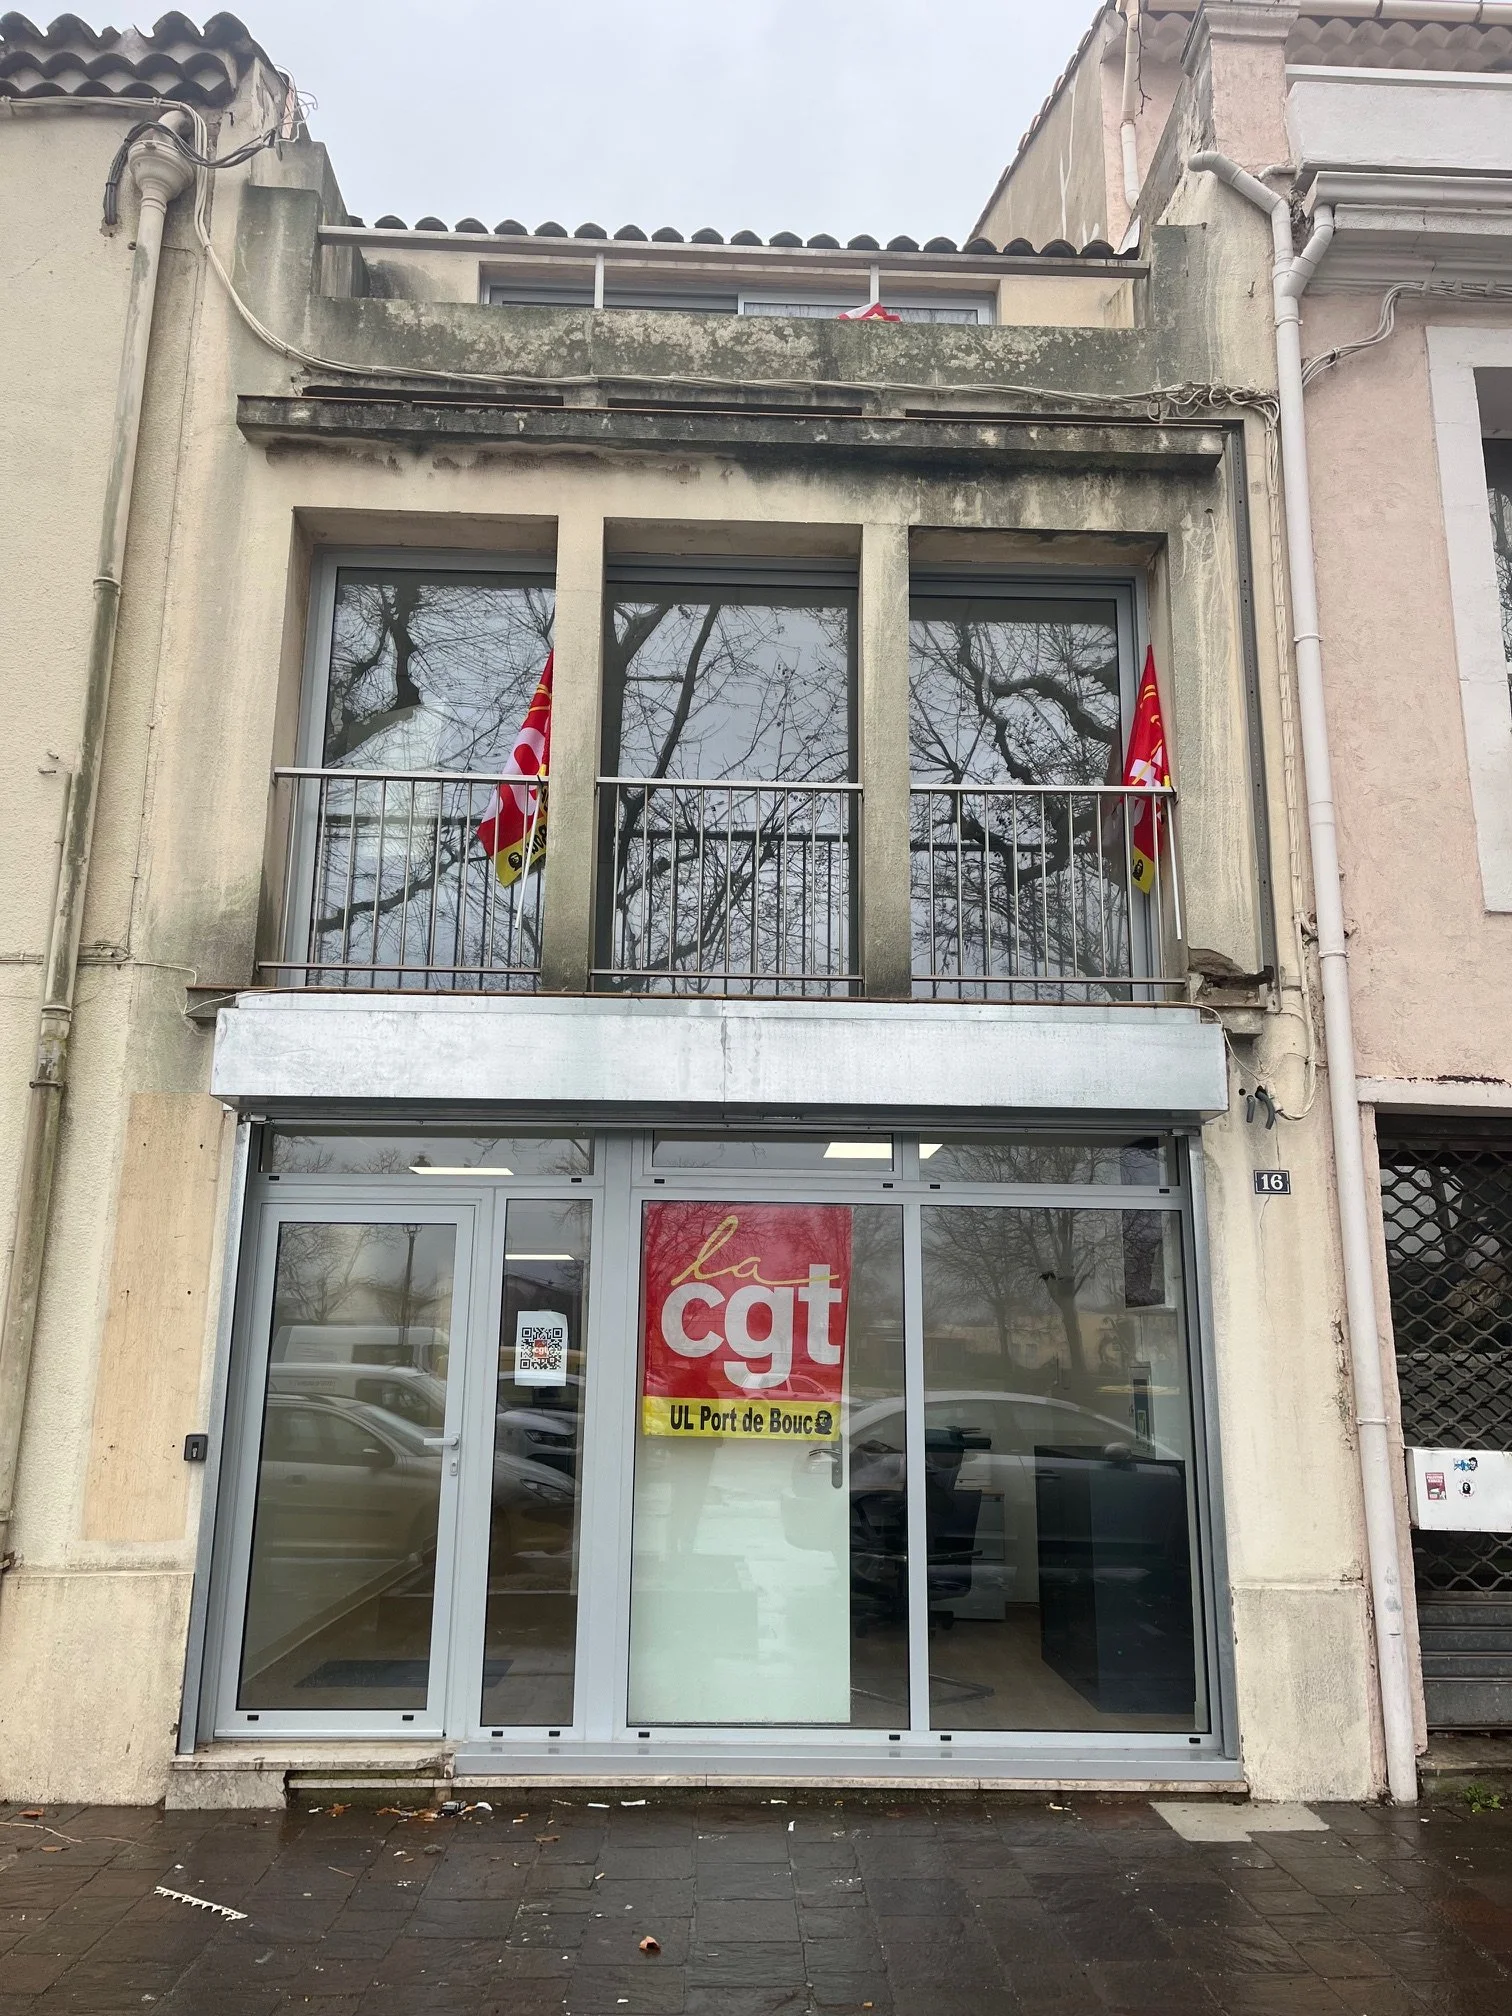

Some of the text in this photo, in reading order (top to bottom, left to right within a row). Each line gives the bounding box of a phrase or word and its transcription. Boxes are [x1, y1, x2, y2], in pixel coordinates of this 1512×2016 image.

[1260, 1173, 1284, 1191] 16
[670, 1215, 840, 1286] la
[661, 1263, 842, 1389] cgt
[670, 1404, 813, 1435] UL Port de Bouc
